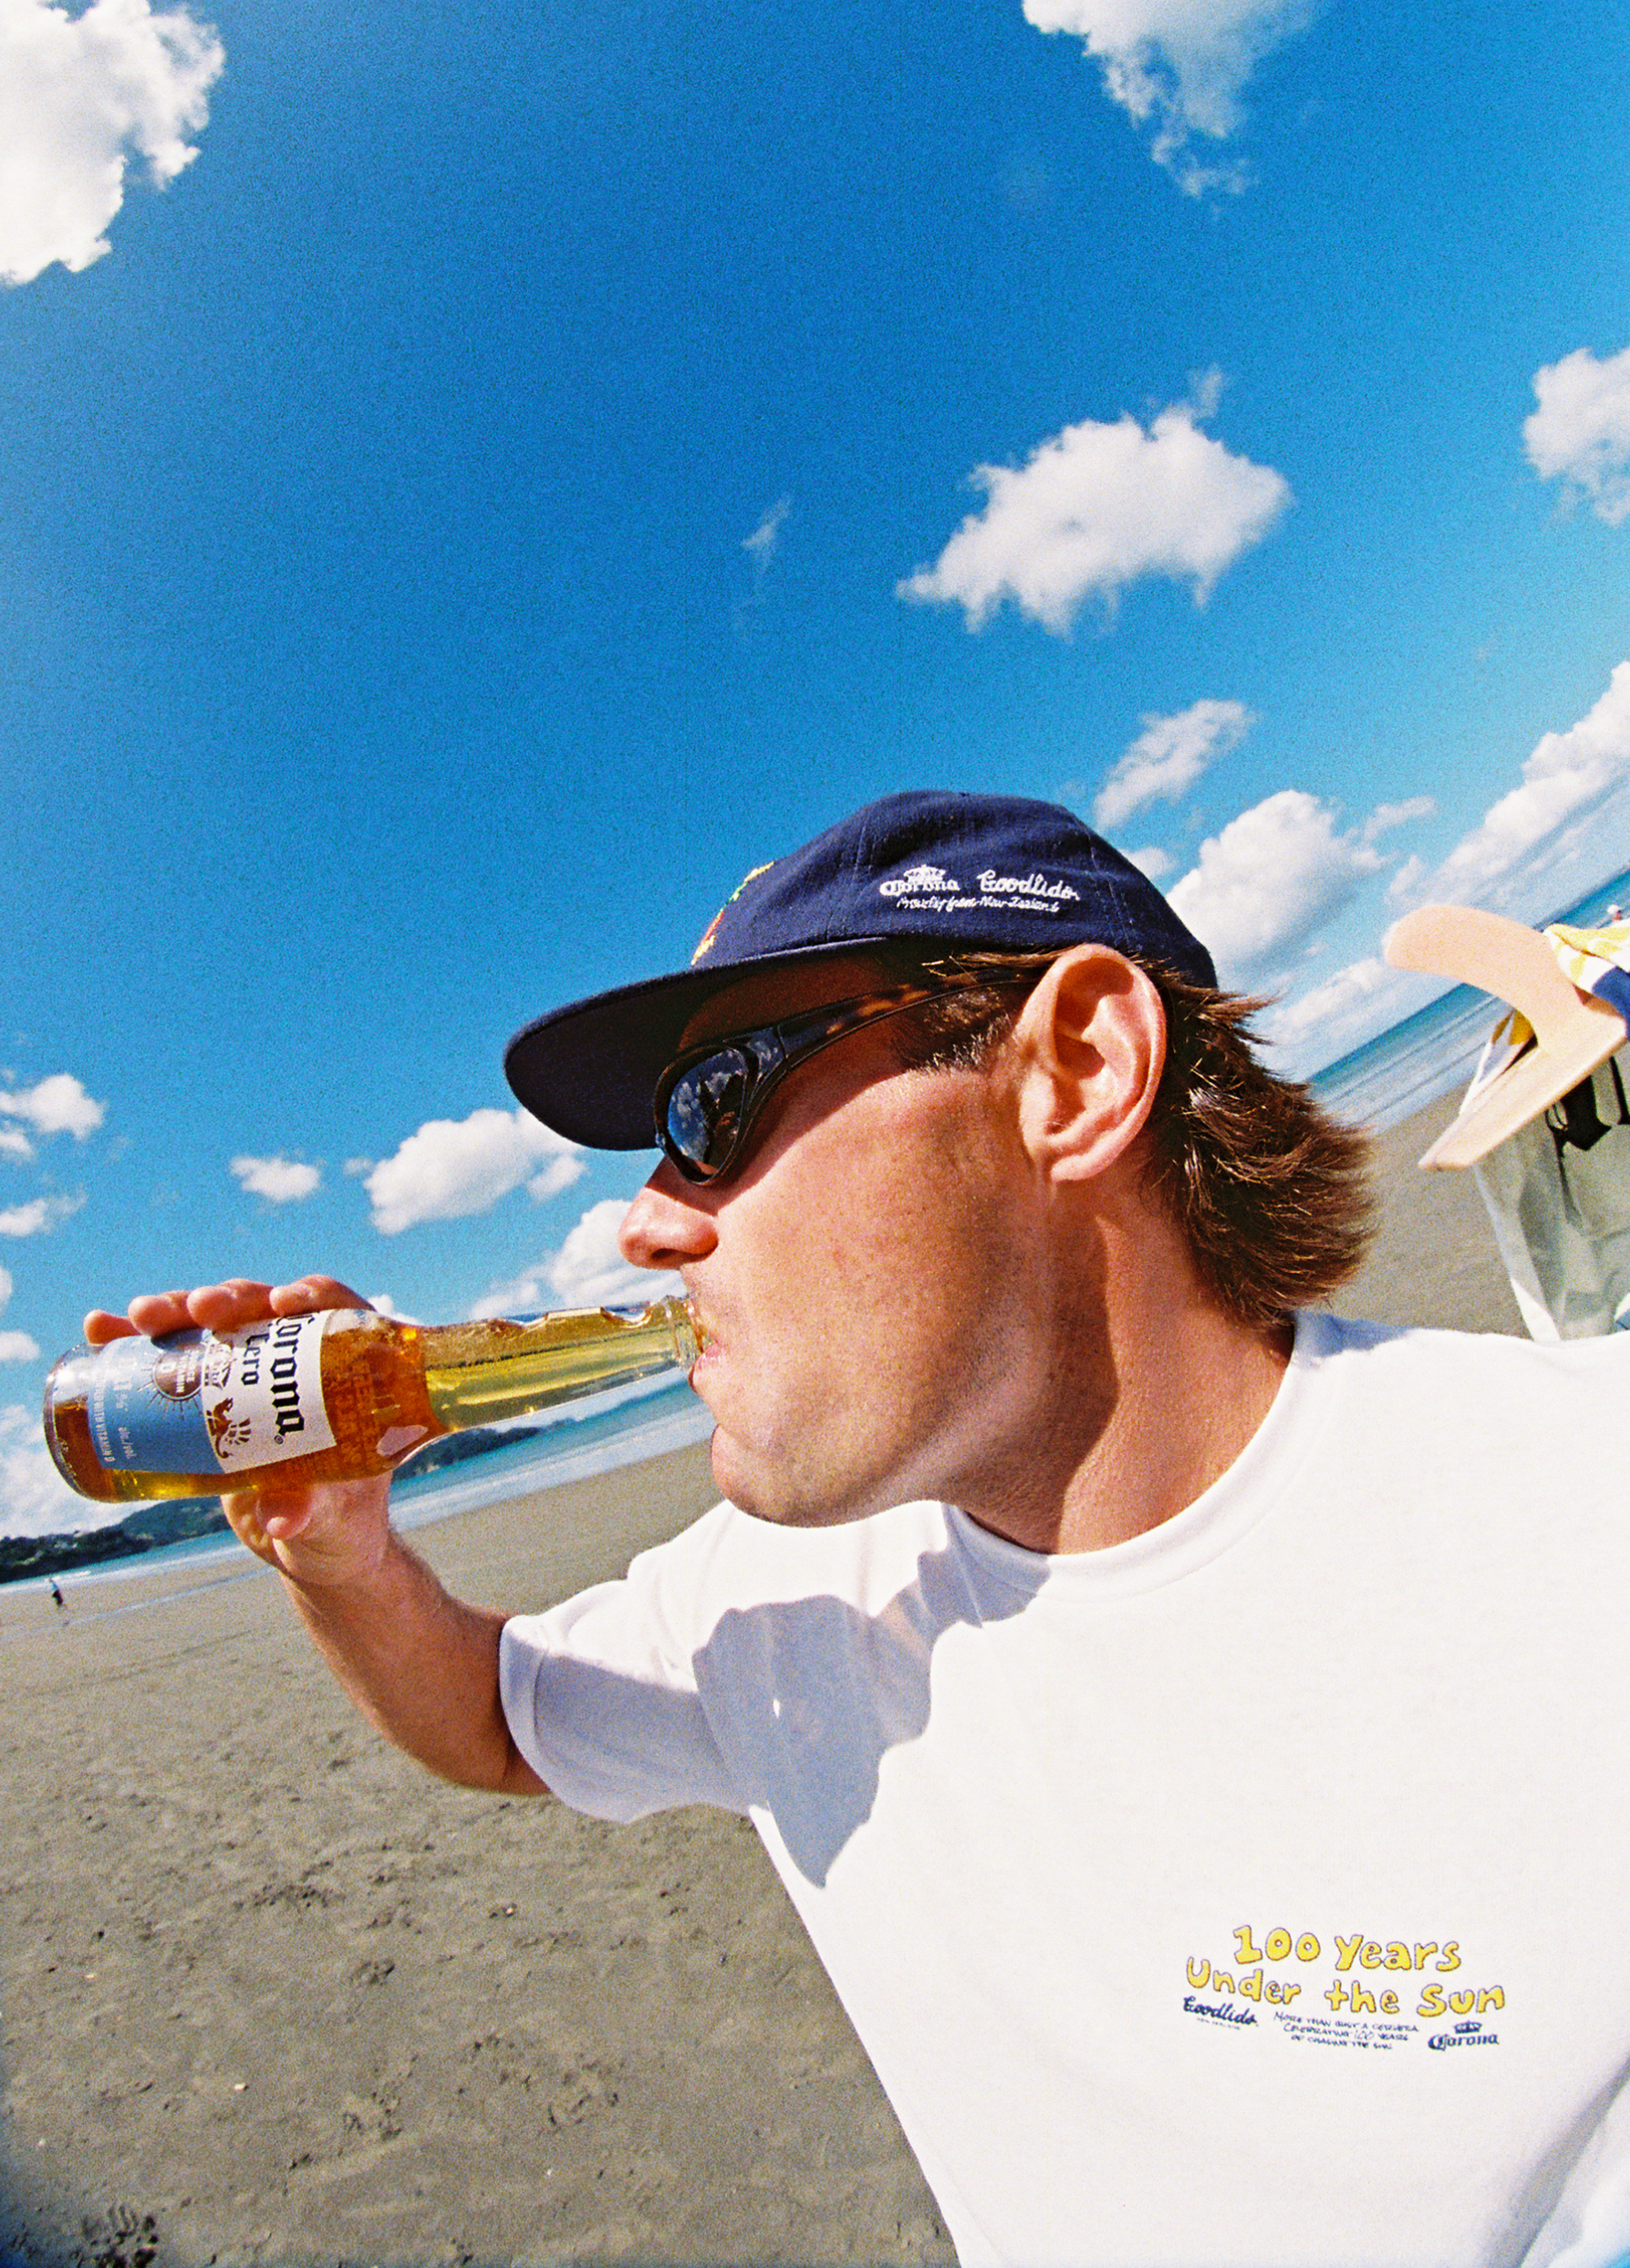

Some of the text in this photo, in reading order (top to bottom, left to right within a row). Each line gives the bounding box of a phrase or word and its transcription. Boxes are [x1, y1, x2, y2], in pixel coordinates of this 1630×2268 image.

[879, 879, 960, 897] Corona
[95, 1423, 113, 1456] VITAMIN
[1233, 1925, 1462, 1971] 100 Years
[1186, 1957, 1506, 2017] Under the Sun
[1273, 2011, 1303, 2024] MORE
[1306, 2017, 1332, 2027] THAN
[1354, 2029, 1376, 2041] 100
[1428, 2033, 1500, 2052] Corona
